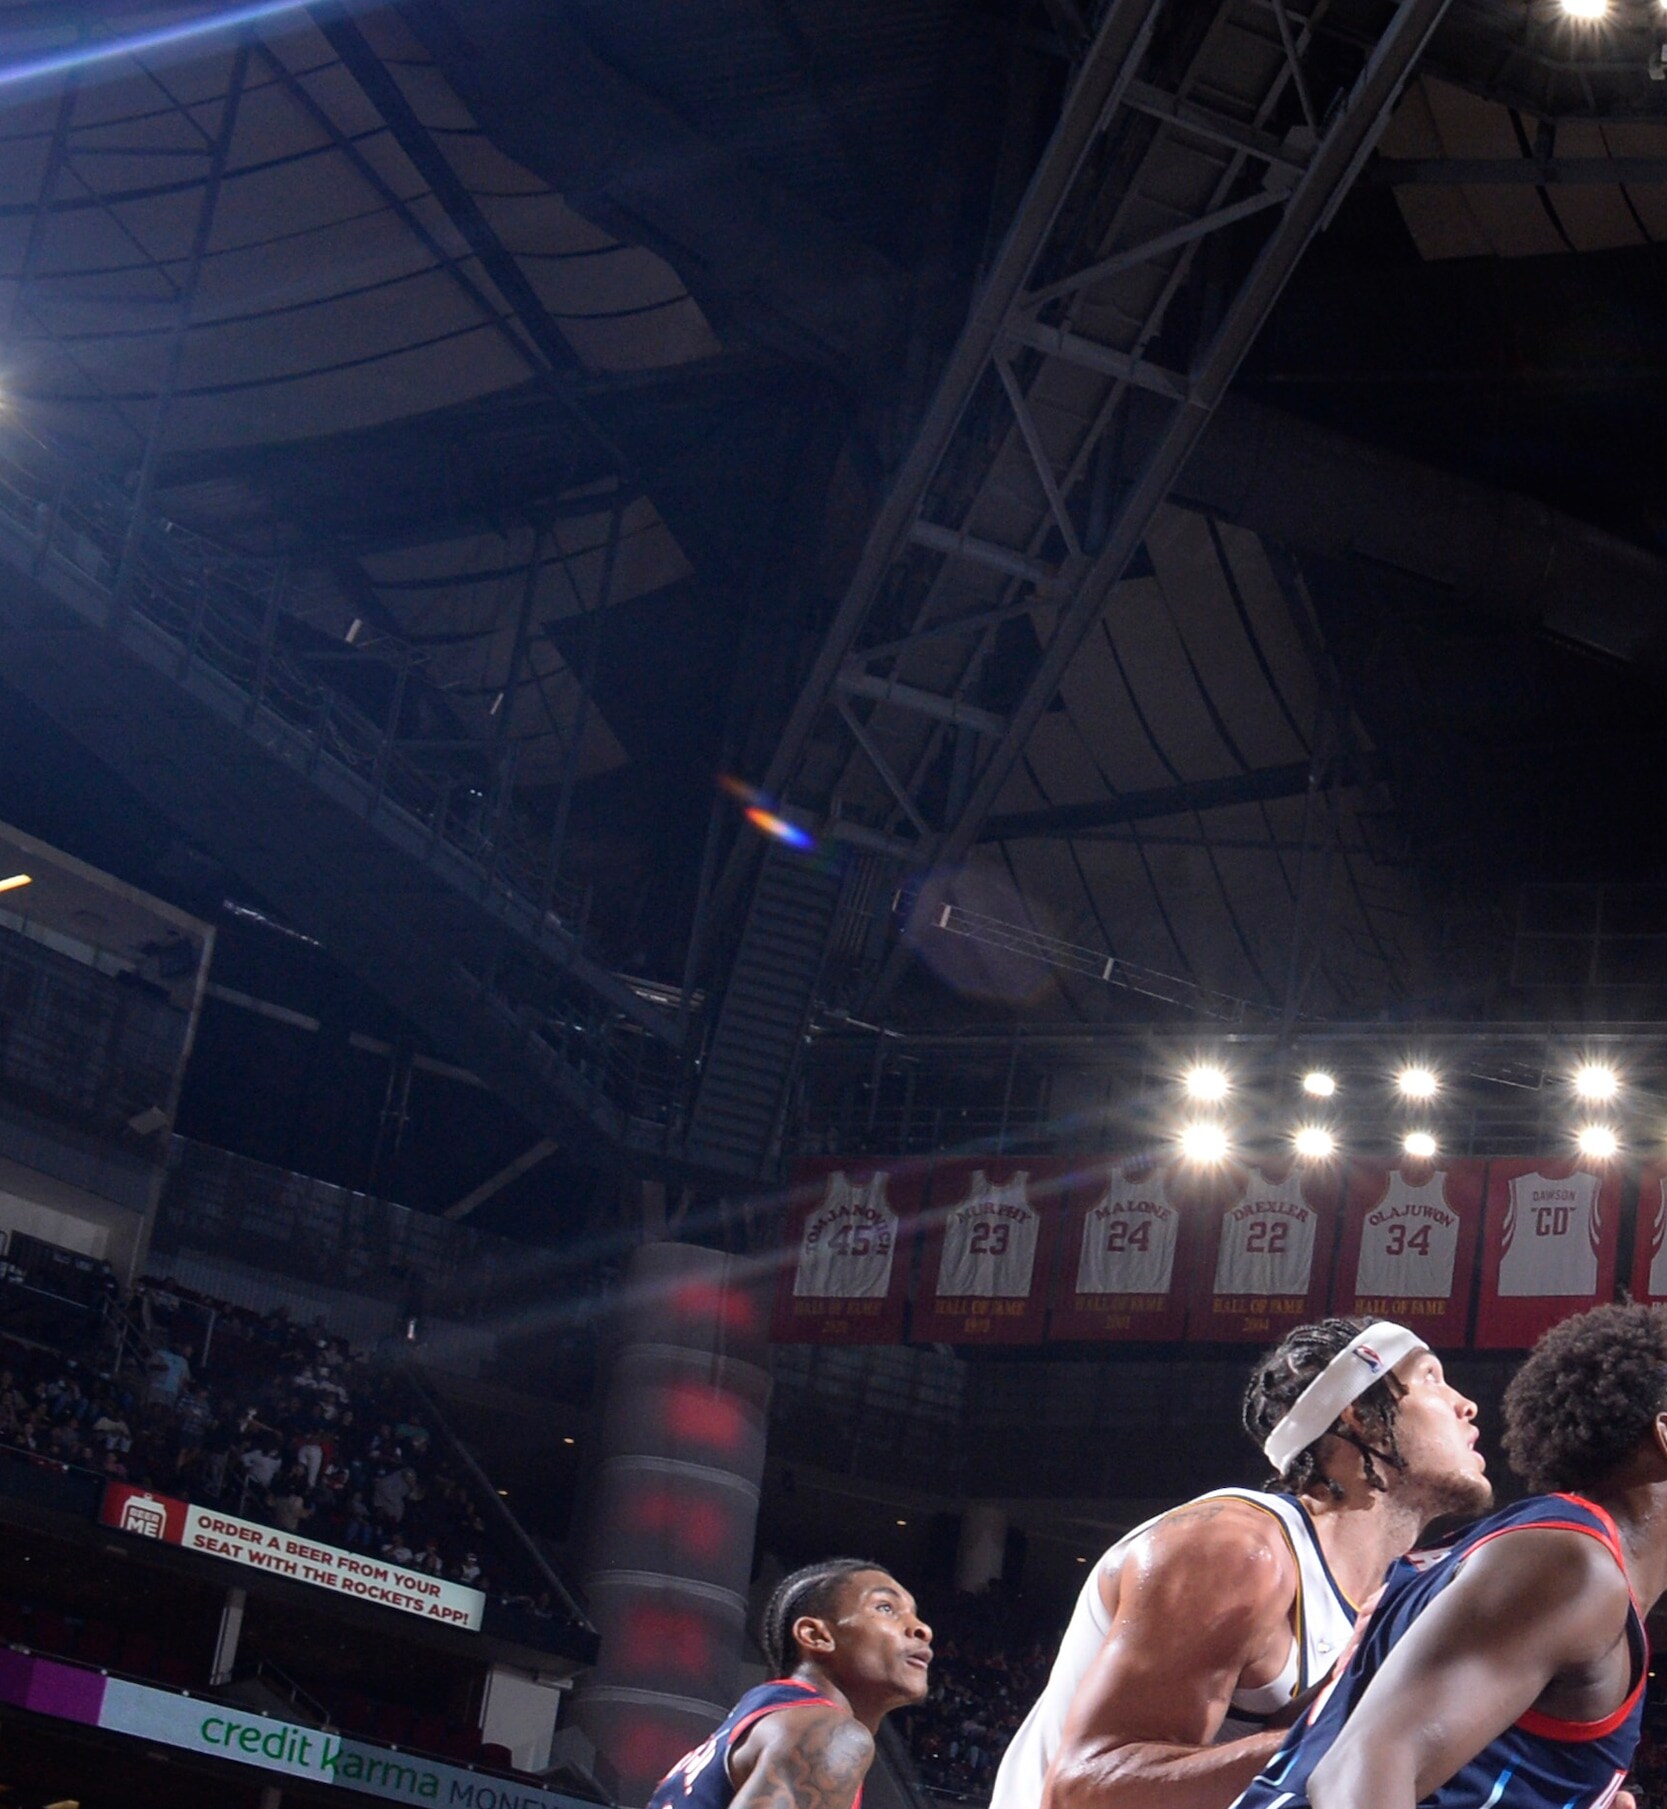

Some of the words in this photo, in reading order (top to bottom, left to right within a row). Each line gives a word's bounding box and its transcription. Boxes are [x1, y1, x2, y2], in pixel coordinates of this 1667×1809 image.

[958, 1203, 1030, 1223] MURPHY
[1095, 1200, 1173, 1221] MALONE
[1231, 1200, 1309, 1223] DREXLER
[1369, 1205, 1455, 1227] OLAJUWON
[828, 1224, 871, 1256] 45
[970, 1222, 1009, 1255] 23
[1107, 1221, 1152, 1252] 24
[1246, 1221, 1288, 1253] 22
[1386, 1224, 1431, 1255] 34
[1355, 1300, 1390, 1316] HALL
[1411, 1300, 1446, 1316] FAME
[128, 1515, 159, 1538] ME
[197, 1516, 262, 1544] ORDER
[267, 1536, 280, 1551] A
[285, 1540, 332, 1566] BEER
[337, 1554, 388, 1582] FROM
[393, 1571, 441, 1598] YOUR
[193, 1534, 243, 1562] SEAT
[248, 1549, 296, 1575] WITH
[302, 1565, 337, 1586] THE
[341, 1576, 424, 1613] ROCKETS
[427, 1604, 469, 1625] APP!
[200, 1717, 310, 1767] credit
[321, 1735, 441, 1799] karma
